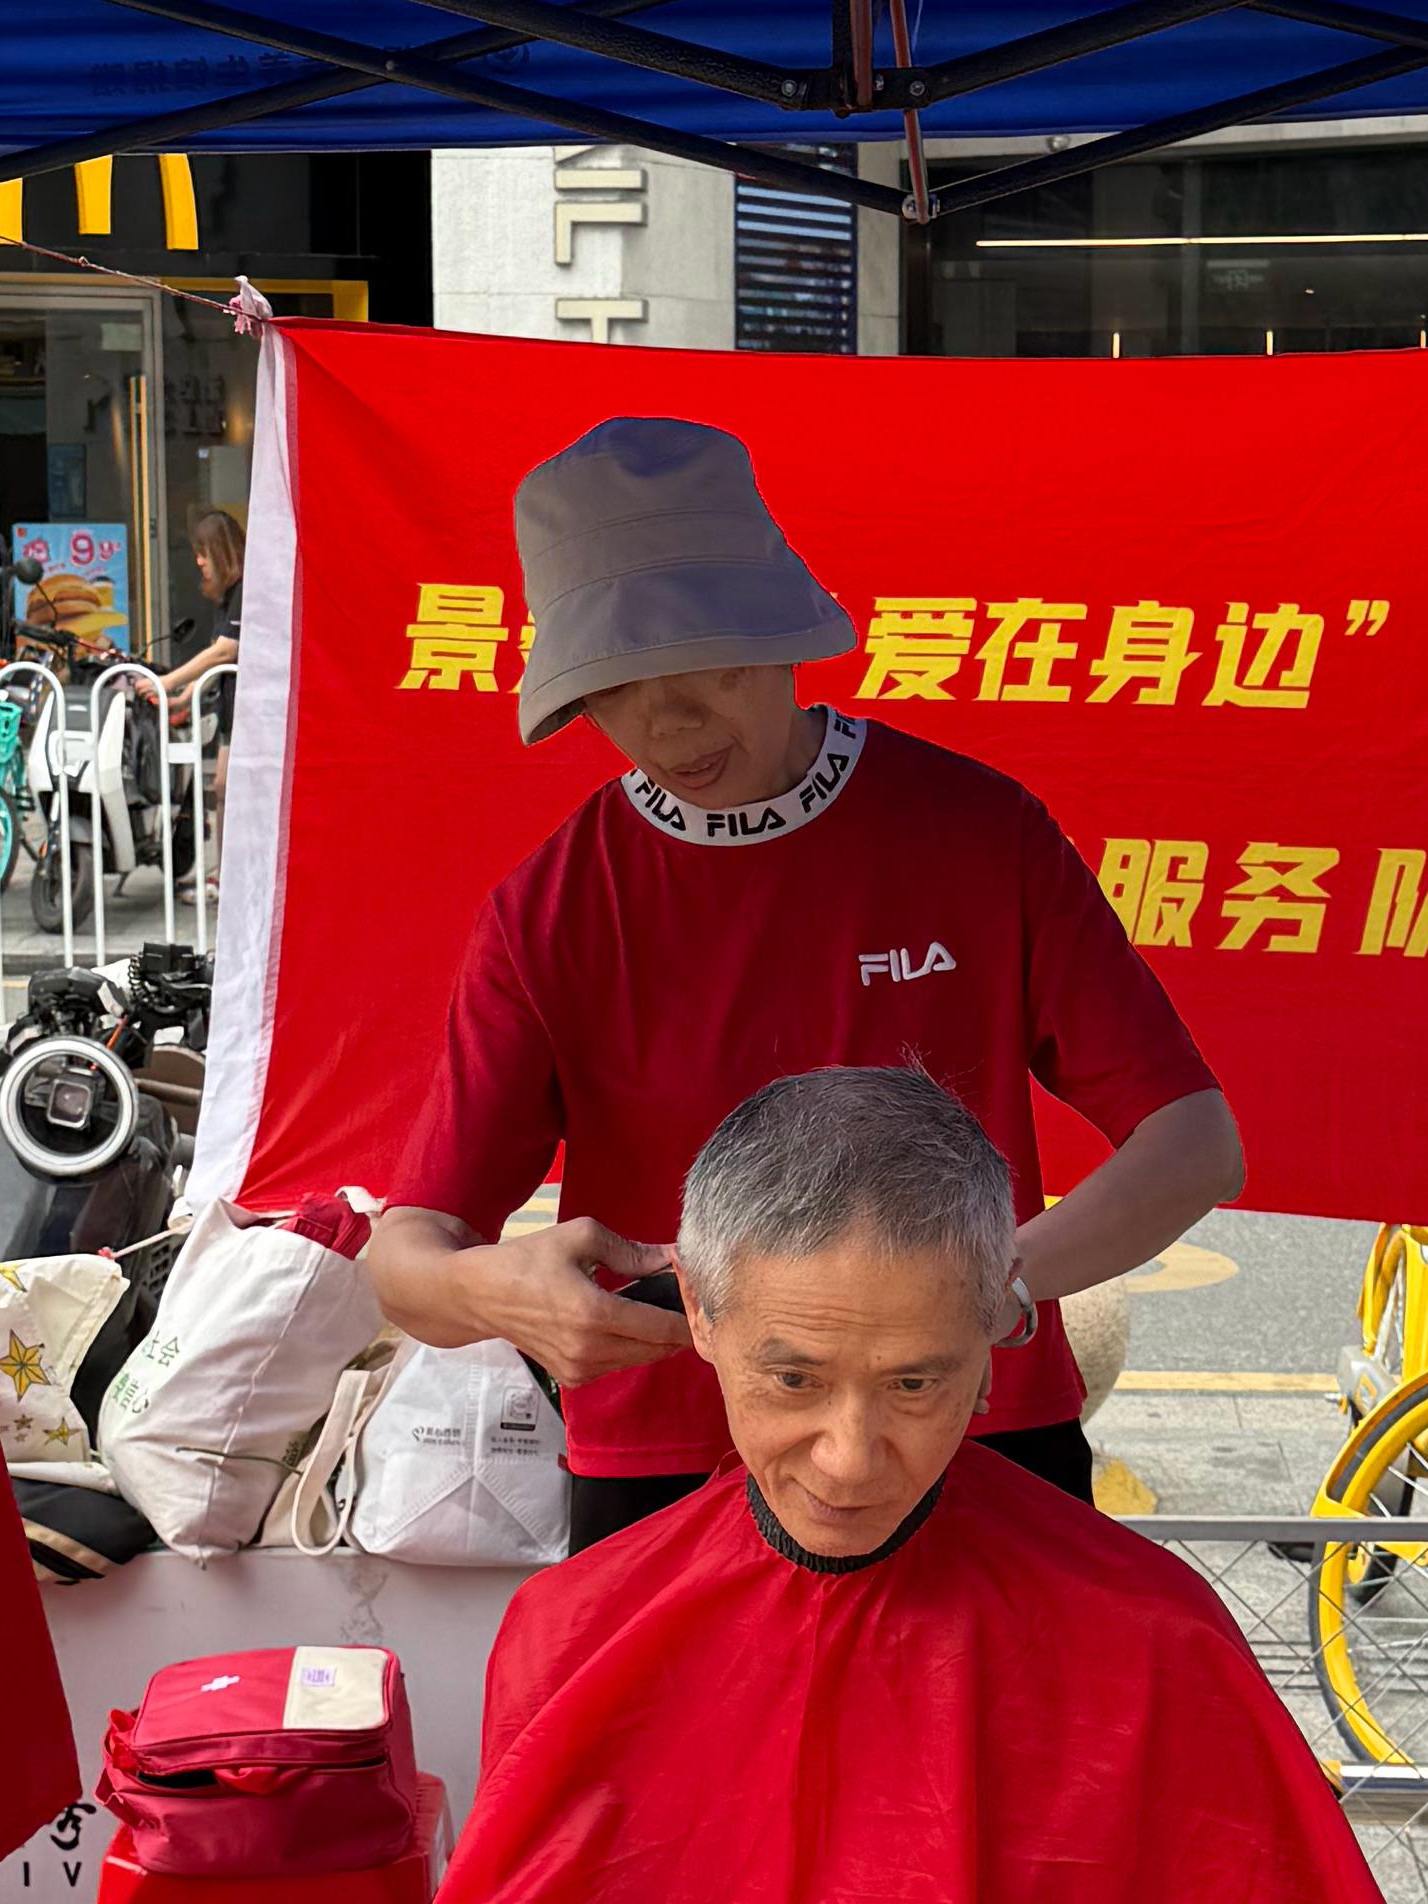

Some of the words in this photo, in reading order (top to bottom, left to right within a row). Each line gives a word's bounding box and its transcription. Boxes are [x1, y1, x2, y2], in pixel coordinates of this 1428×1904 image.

[800, 753, 850, 814] FILA
[706, 807, 787, 837] FILA
[859, 942, 957, 986] FILA
